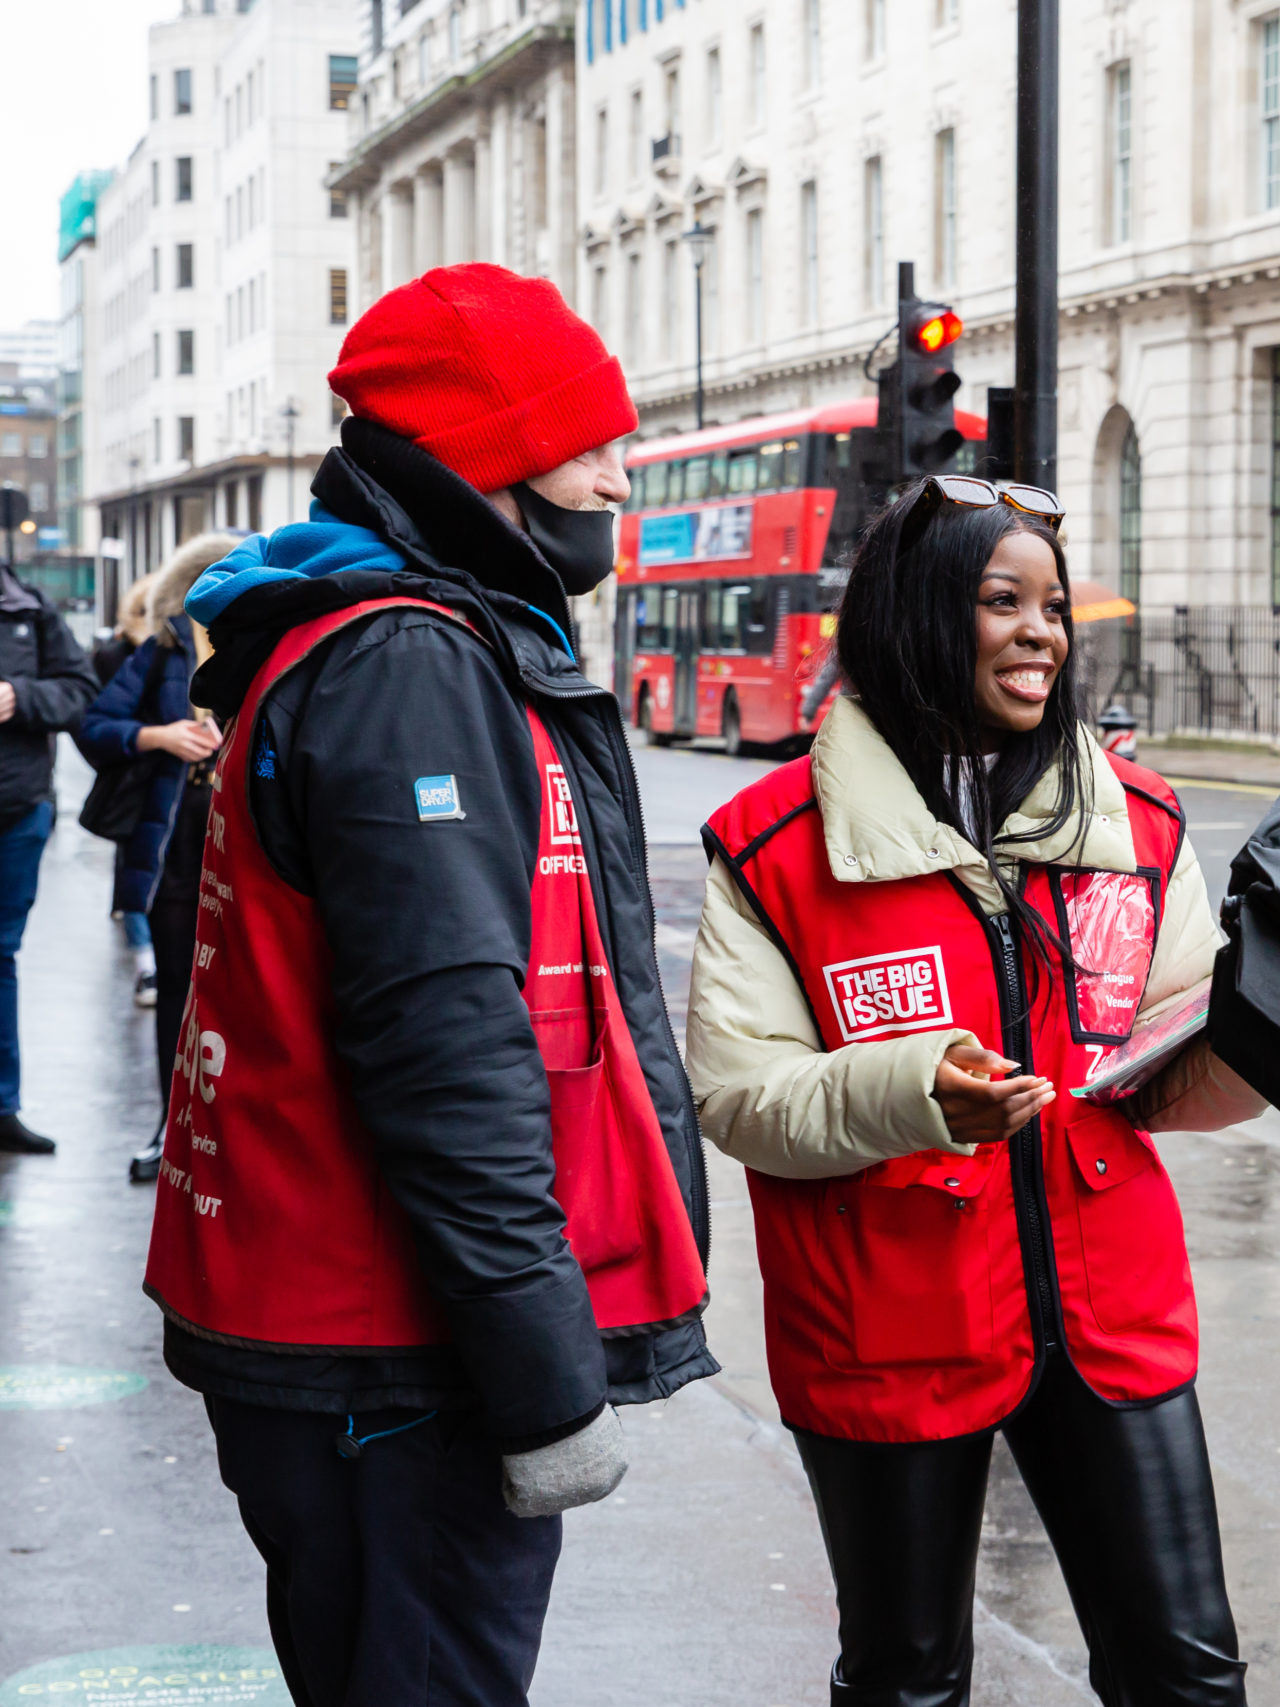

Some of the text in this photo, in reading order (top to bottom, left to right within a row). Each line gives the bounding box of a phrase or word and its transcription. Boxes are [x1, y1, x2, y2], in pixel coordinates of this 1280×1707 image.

[198, 944, 216, 970] BY
[538, 962, 572, 976] Award
[837, 960, 932, 997] THE BIG
[1103, 970, 1135, 987] Rogue
[843, 984, 938, 1028] ISSUE
[1105, 994, 1135, 1009] Vendor
[79, 1665, 139, 1680] GO
